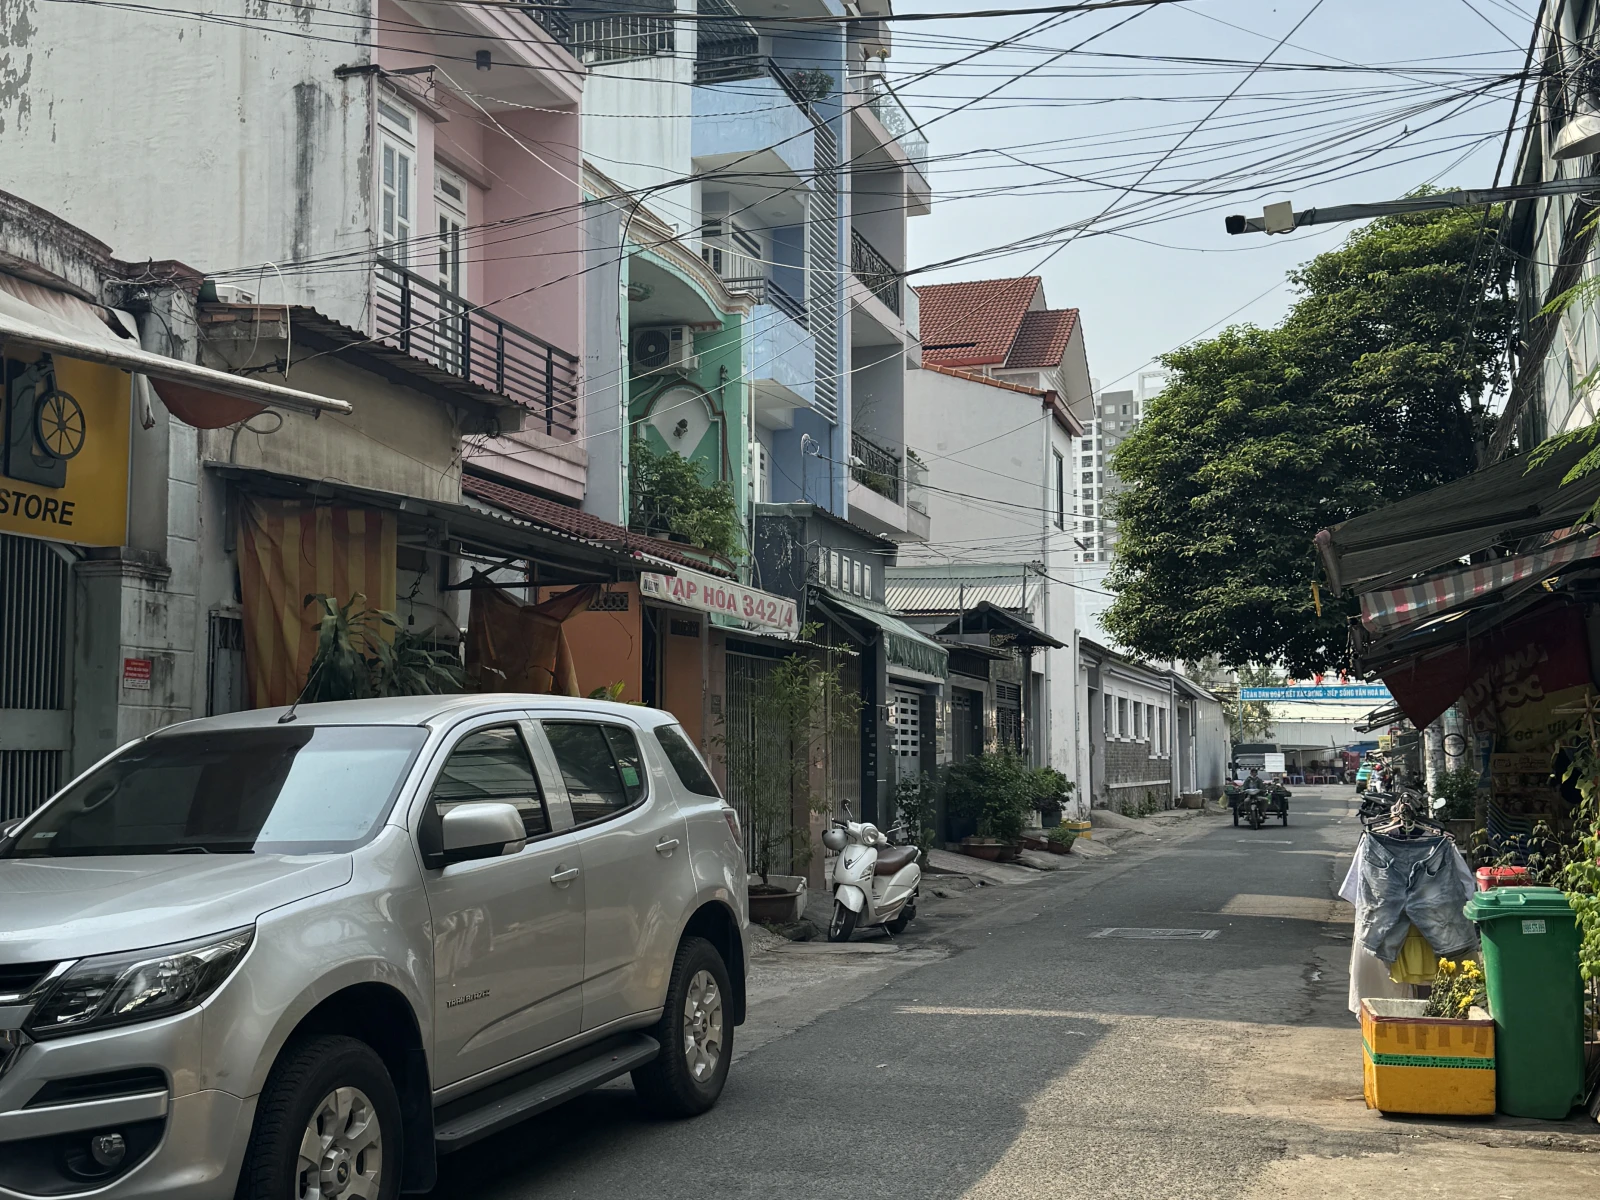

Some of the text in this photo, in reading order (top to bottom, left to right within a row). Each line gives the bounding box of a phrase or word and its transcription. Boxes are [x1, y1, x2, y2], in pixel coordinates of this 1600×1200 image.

[0, 488, 75, 526] STORE
[664, 575, 698, 602] TẠP
[703, 586, 738, 613] HÓA
[742, 594, 794, 628] 342/4
